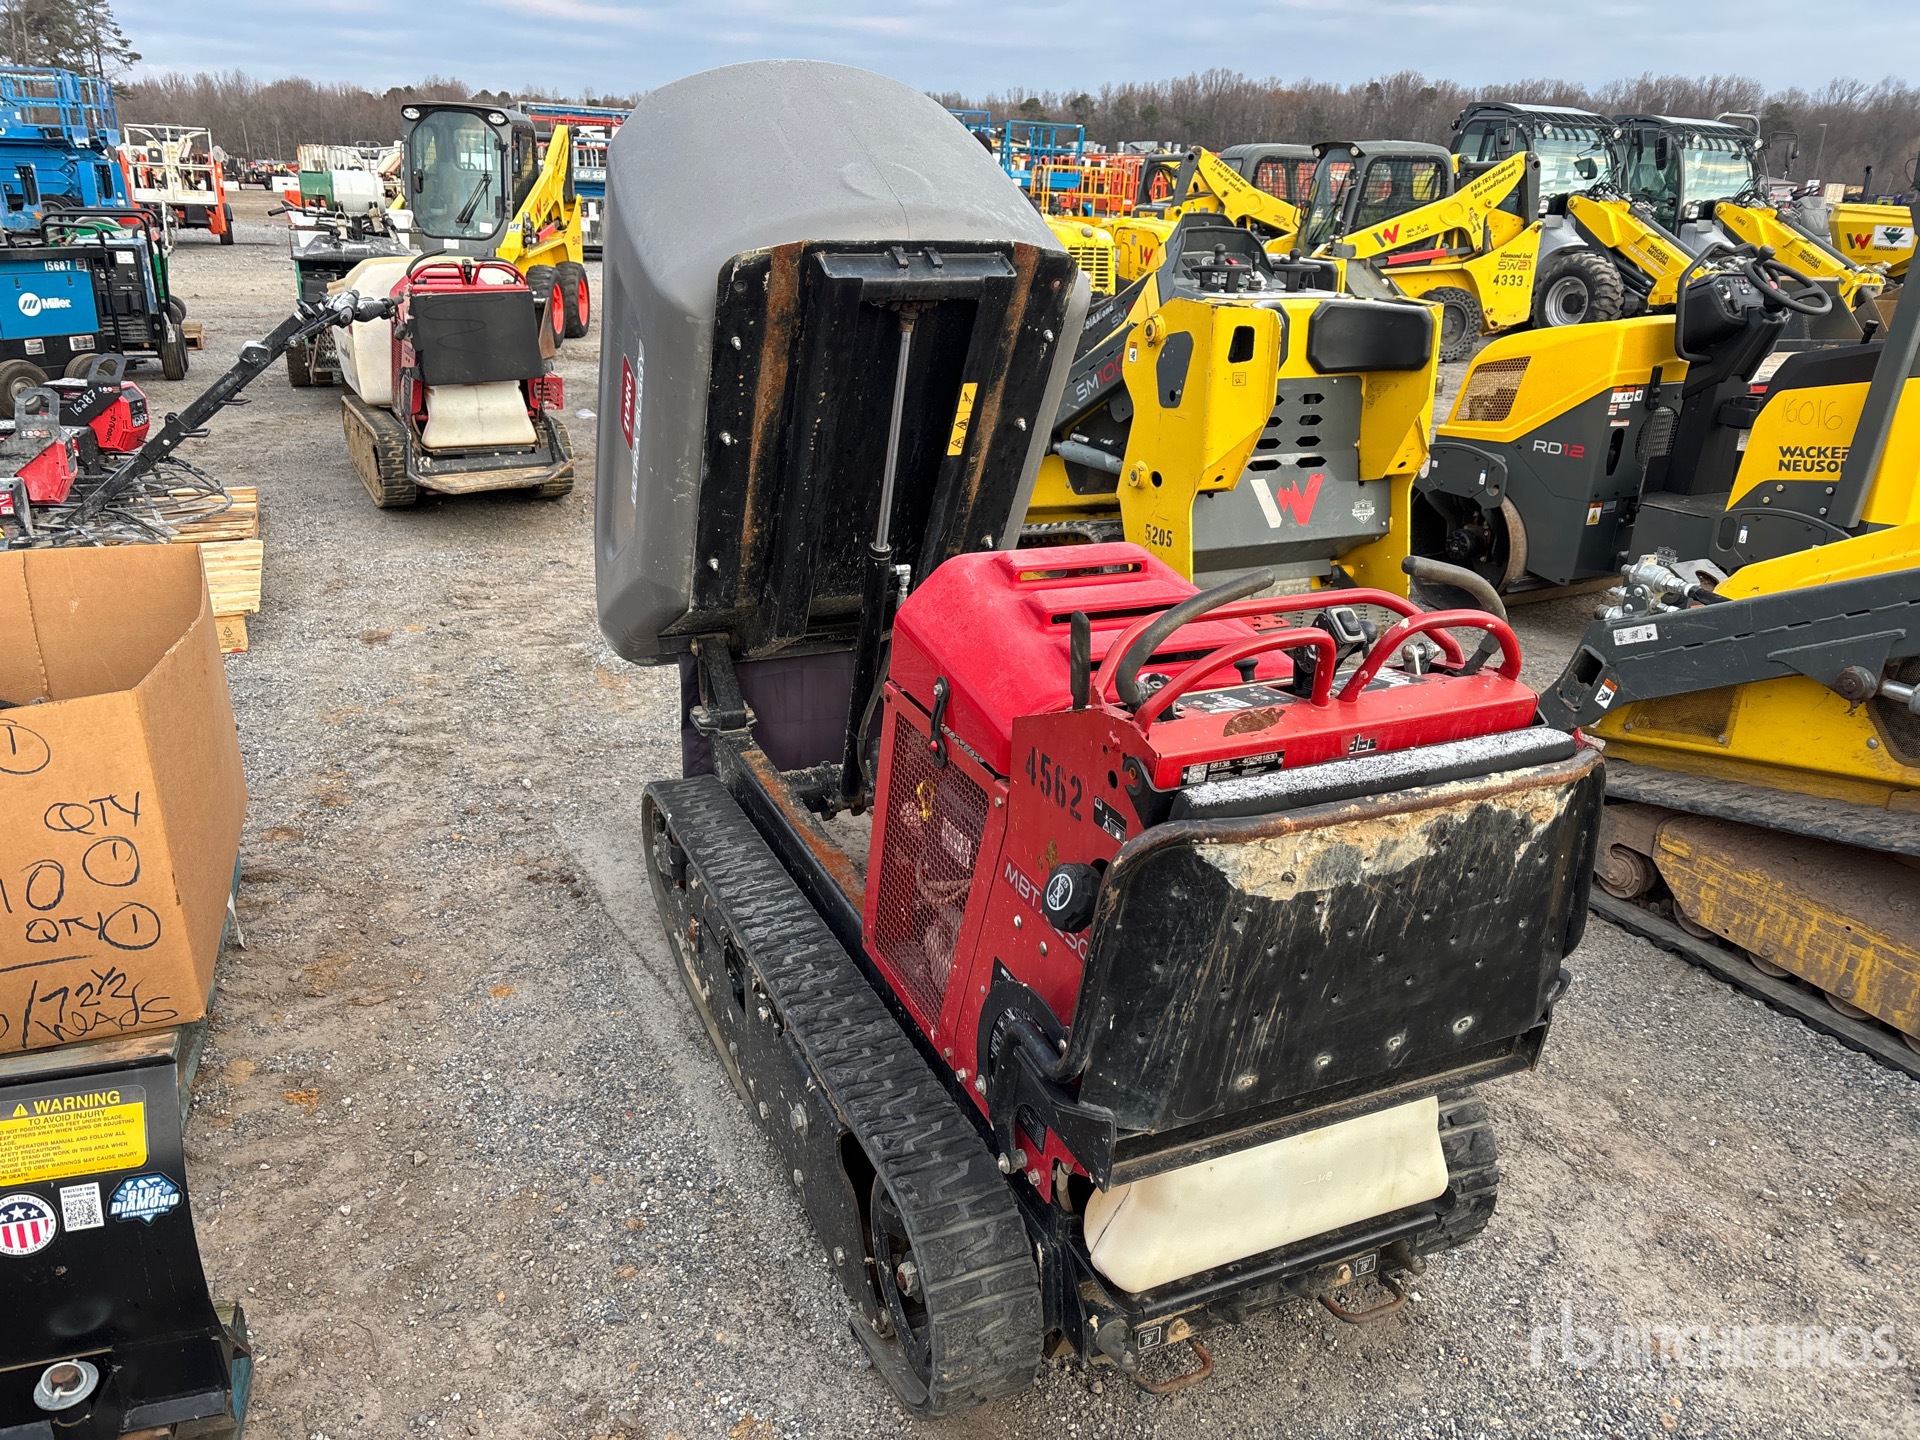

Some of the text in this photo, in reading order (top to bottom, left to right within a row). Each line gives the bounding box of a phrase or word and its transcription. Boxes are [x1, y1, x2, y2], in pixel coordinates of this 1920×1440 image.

[1647, 248, 1668, 266] NEUSON
[1650, 243, 1670, 260] WACKER
[1801, 248, 1822, 264] WACKER
[44, 260, 71, 271] 15687
[1497, 260, 1532, 270] SW21
[1798, 252, 1819, 270] NEUSON
[1492, 274, 1524, 287] 4333
[41, 297, 72, 309] Miller
[70, 389, 97, 417] 16287
[623, 370, 632, 434] TORO
[1782, 398, 1843, 431] 16016
[631, 352, 644, 505] ULTRA BUGGY
[1532, 440, 1585, 459] RD12
[1778, 460, 1843, 473] NEUSO
[1145, 523, 1172, 547] 5205
[1025, 746, 1082, 822] 4562
[44, 791, 141, 835] QTY
[26, 911, 103, 944] QTY
[33, 1090, 120, 1115] WARNING
[20, 1124, 46, 1133] POSITION
[103, 1114, 123, 1122] BLADE.
[28, 1109, 106, 1126] TO AVOID INJURY
[103, 1118, 134, 1127] ADJUSTING
[14, 1142, 49, 1151] OPERATORS
[89, 1132, 113, 1140] FOLLOW
[20, 1146, 62, 1155] PRECAUTIONS.
[28, 1158, 55, 1166] RUNNING.
[51, 1160, 81, 1168] WARNINGS
[117, 1151, 137, 1159] INJURY
[126, 1185, 163, 1202] BLUE
[33, 1198, 45, 1208] USA
[110, 1193, 179, 1215] DIAMOND
[26, 1245, 38, 1253] THE
[39, 1235, 50, 1246] USA
